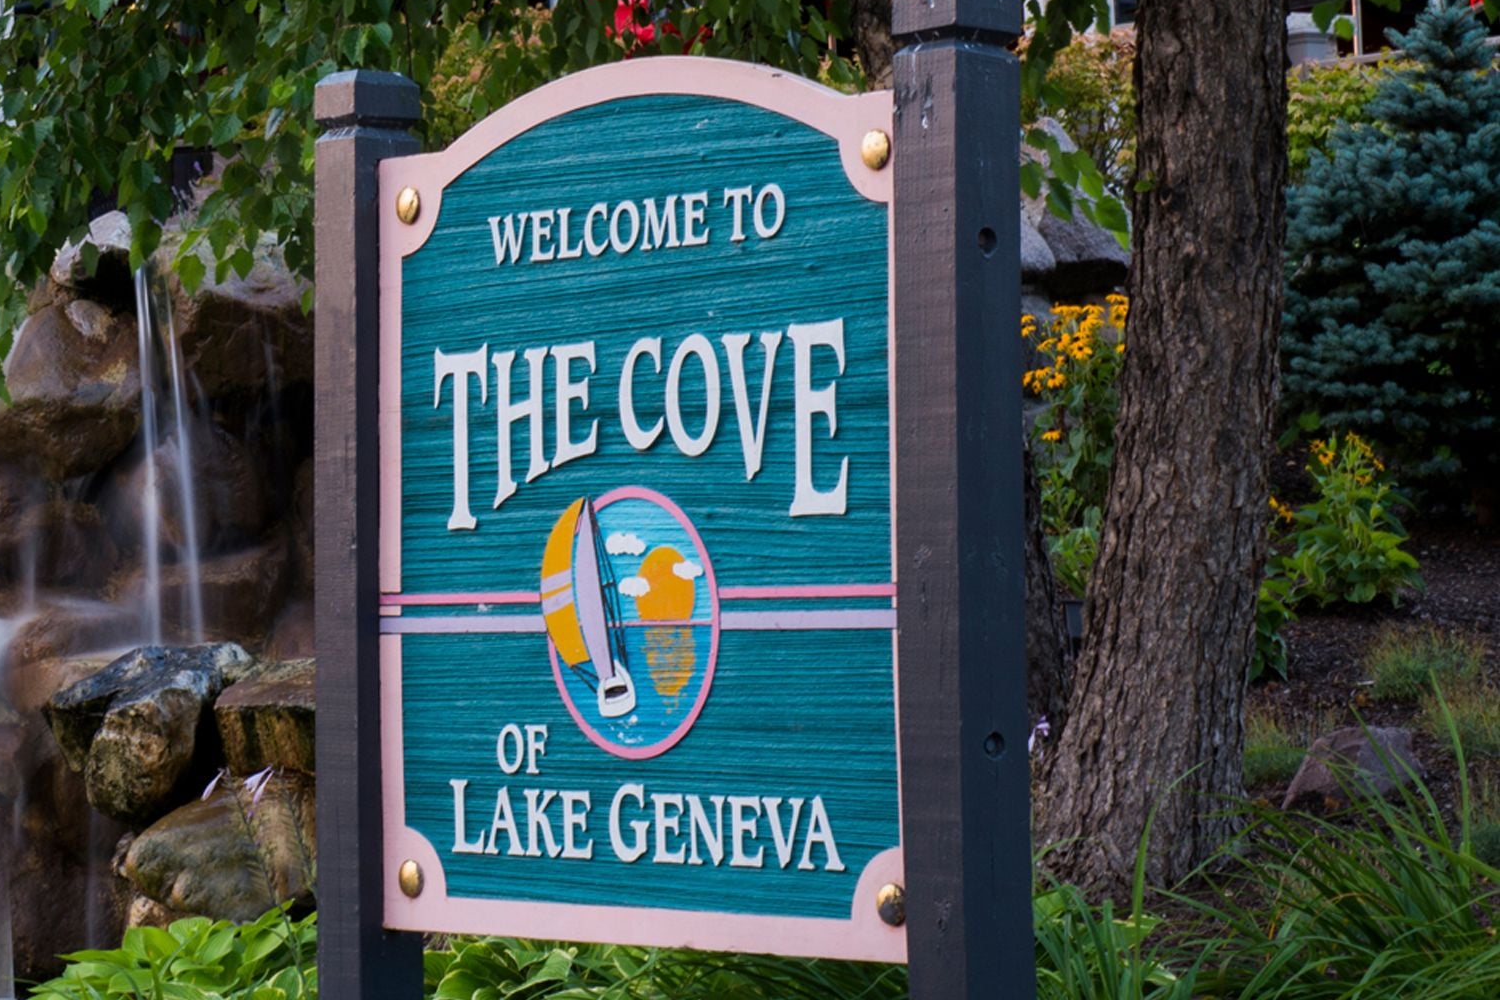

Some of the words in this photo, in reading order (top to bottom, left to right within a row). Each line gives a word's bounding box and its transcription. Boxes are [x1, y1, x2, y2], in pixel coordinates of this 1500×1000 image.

[487, 191, 710, 265] WELCOME
[723, 184, 786, 241] TO
[434, 340, 600, 530] THE
[618, 318, 849, 518] COVE
[497, 723, 549, 775] OF
[450, 779, 593, 860] LAKE
[609, 784, 846, 872] GENEVA
